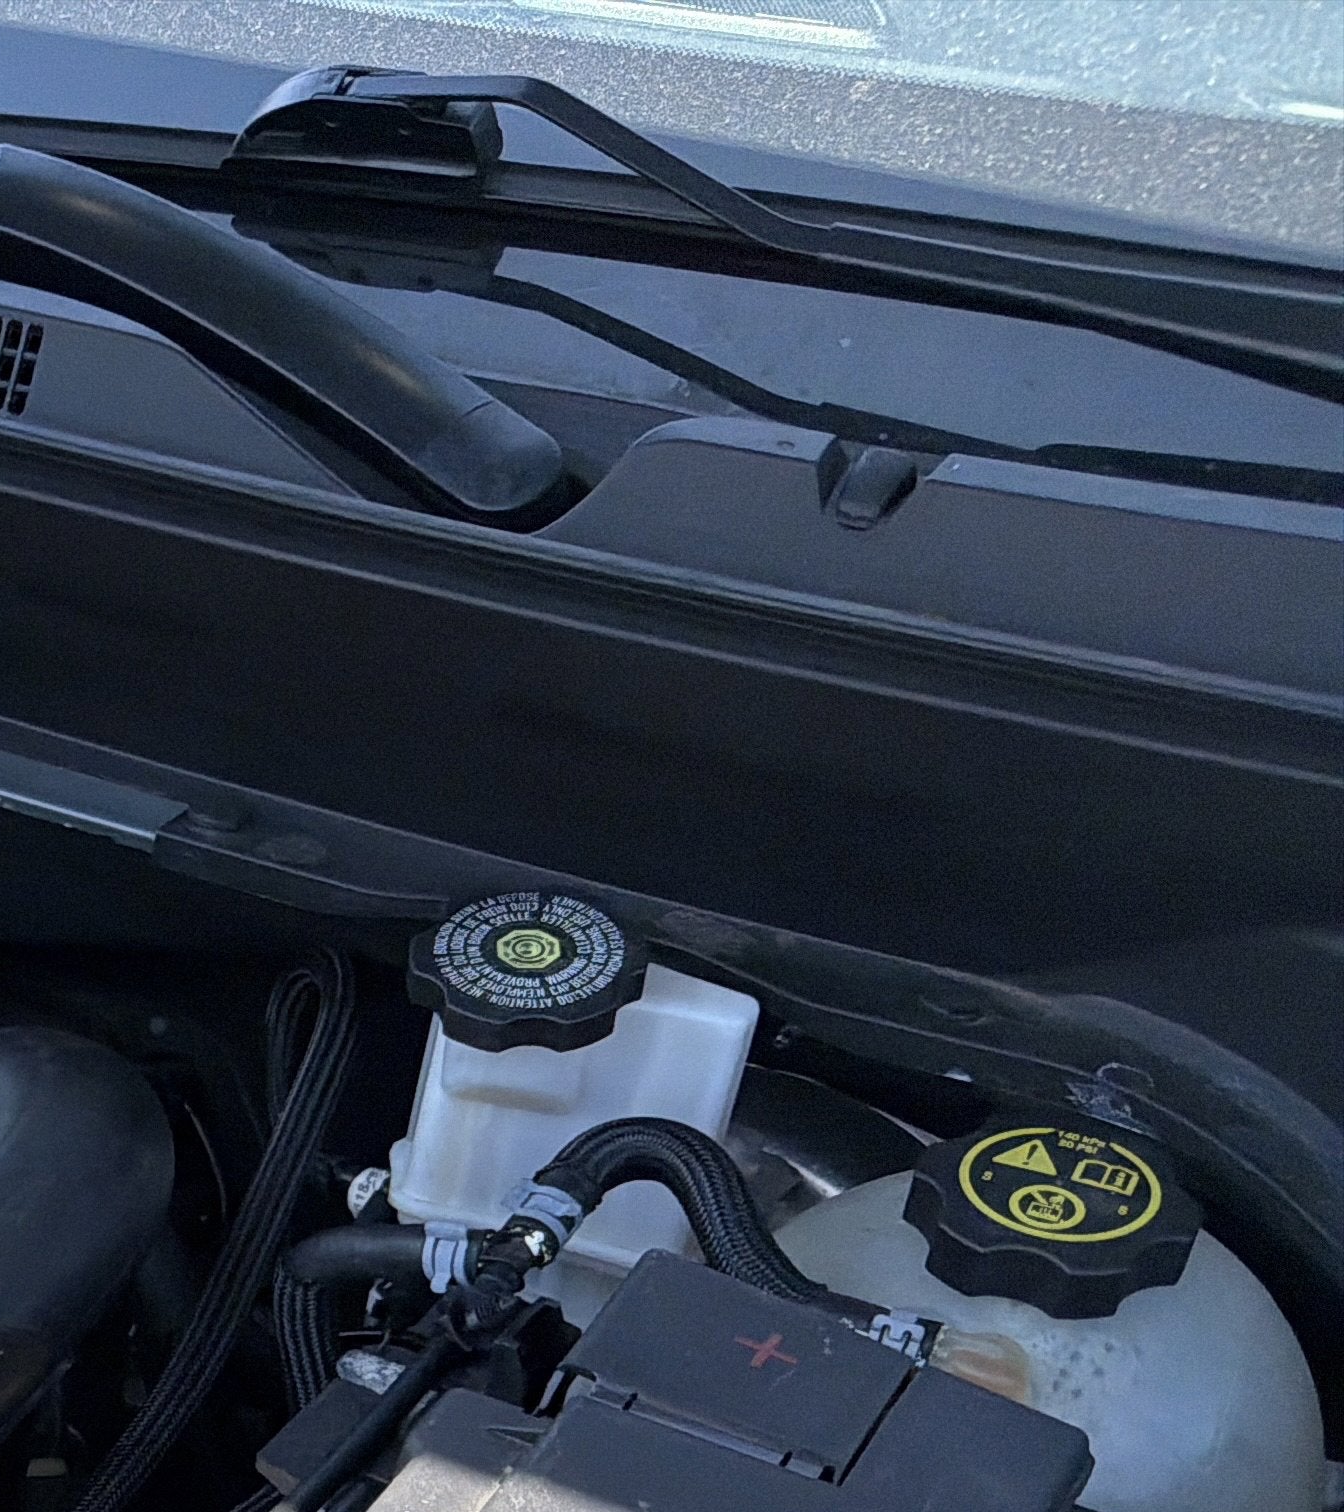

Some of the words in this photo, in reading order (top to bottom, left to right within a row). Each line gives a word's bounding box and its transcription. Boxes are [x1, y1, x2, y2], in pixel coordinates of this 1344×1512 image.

[543, 904, 573, 917] ONLY
[569, 913, 591, 927] USE
[549, 983, 569, 995] CAP
